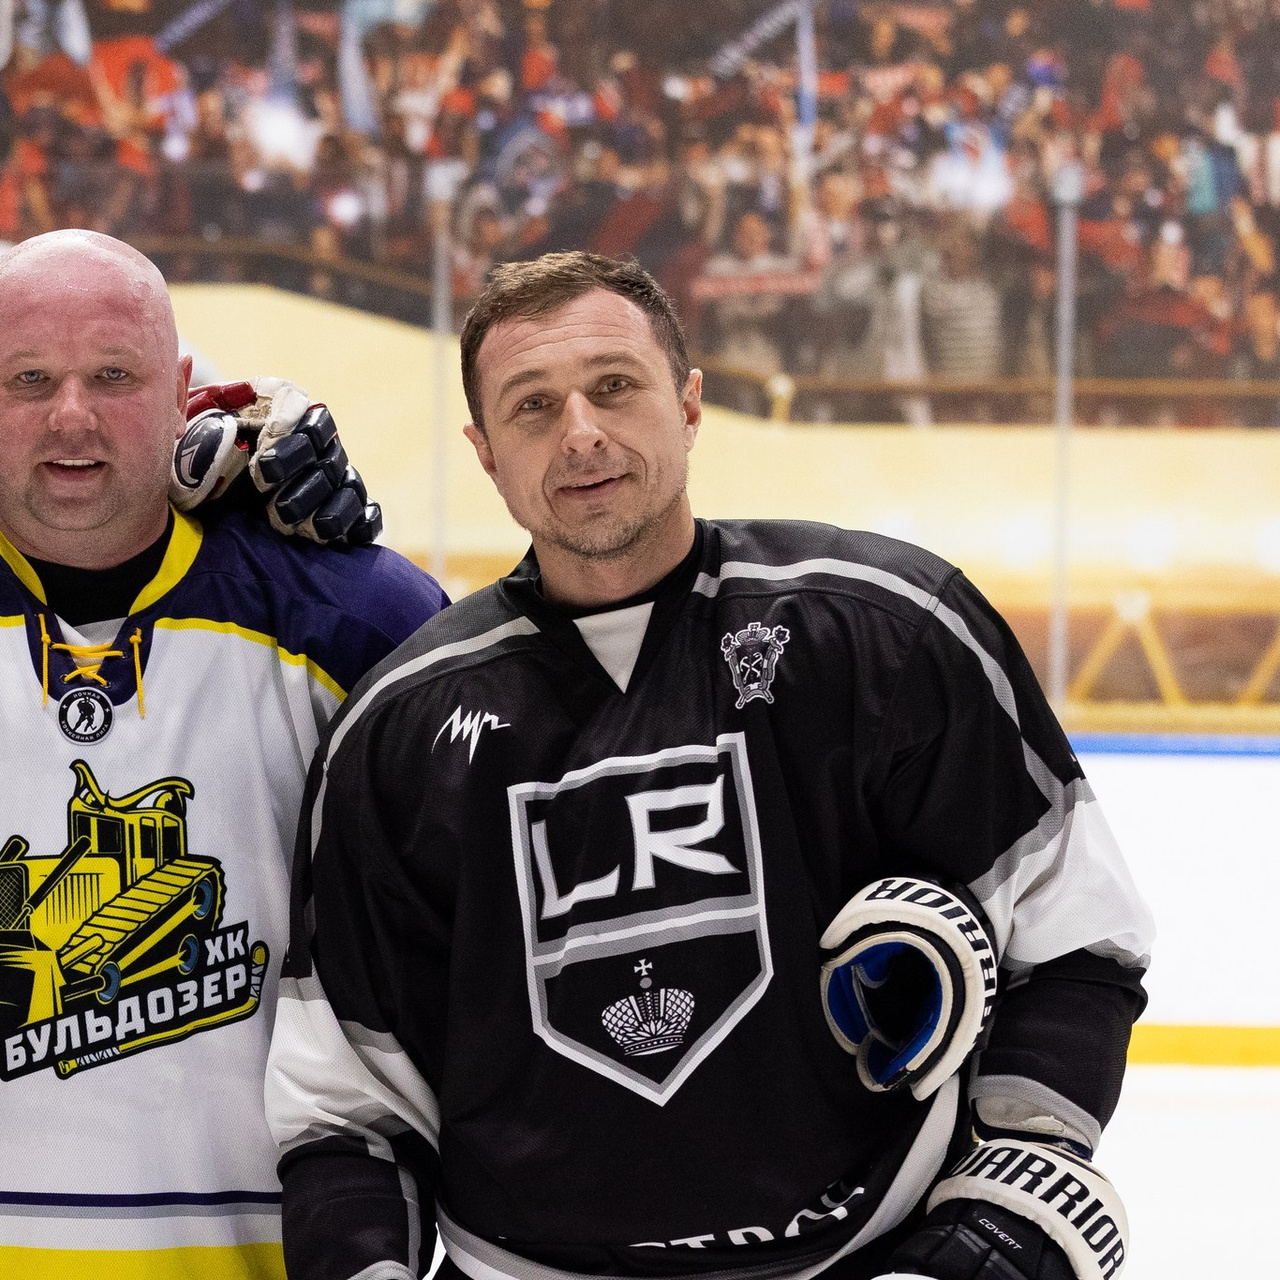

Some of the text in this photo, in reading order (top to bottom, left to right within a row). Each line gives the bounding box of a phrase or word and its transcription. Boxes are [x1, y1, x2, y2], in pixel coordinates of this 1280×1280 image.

[531, 774, 742, 920] LR
[204, 929, 246, 966] ХК
[5, 963, 247, 1071] БУЛЬДОЗЕР
[978, 1218, 1022, 1250] COVERT
